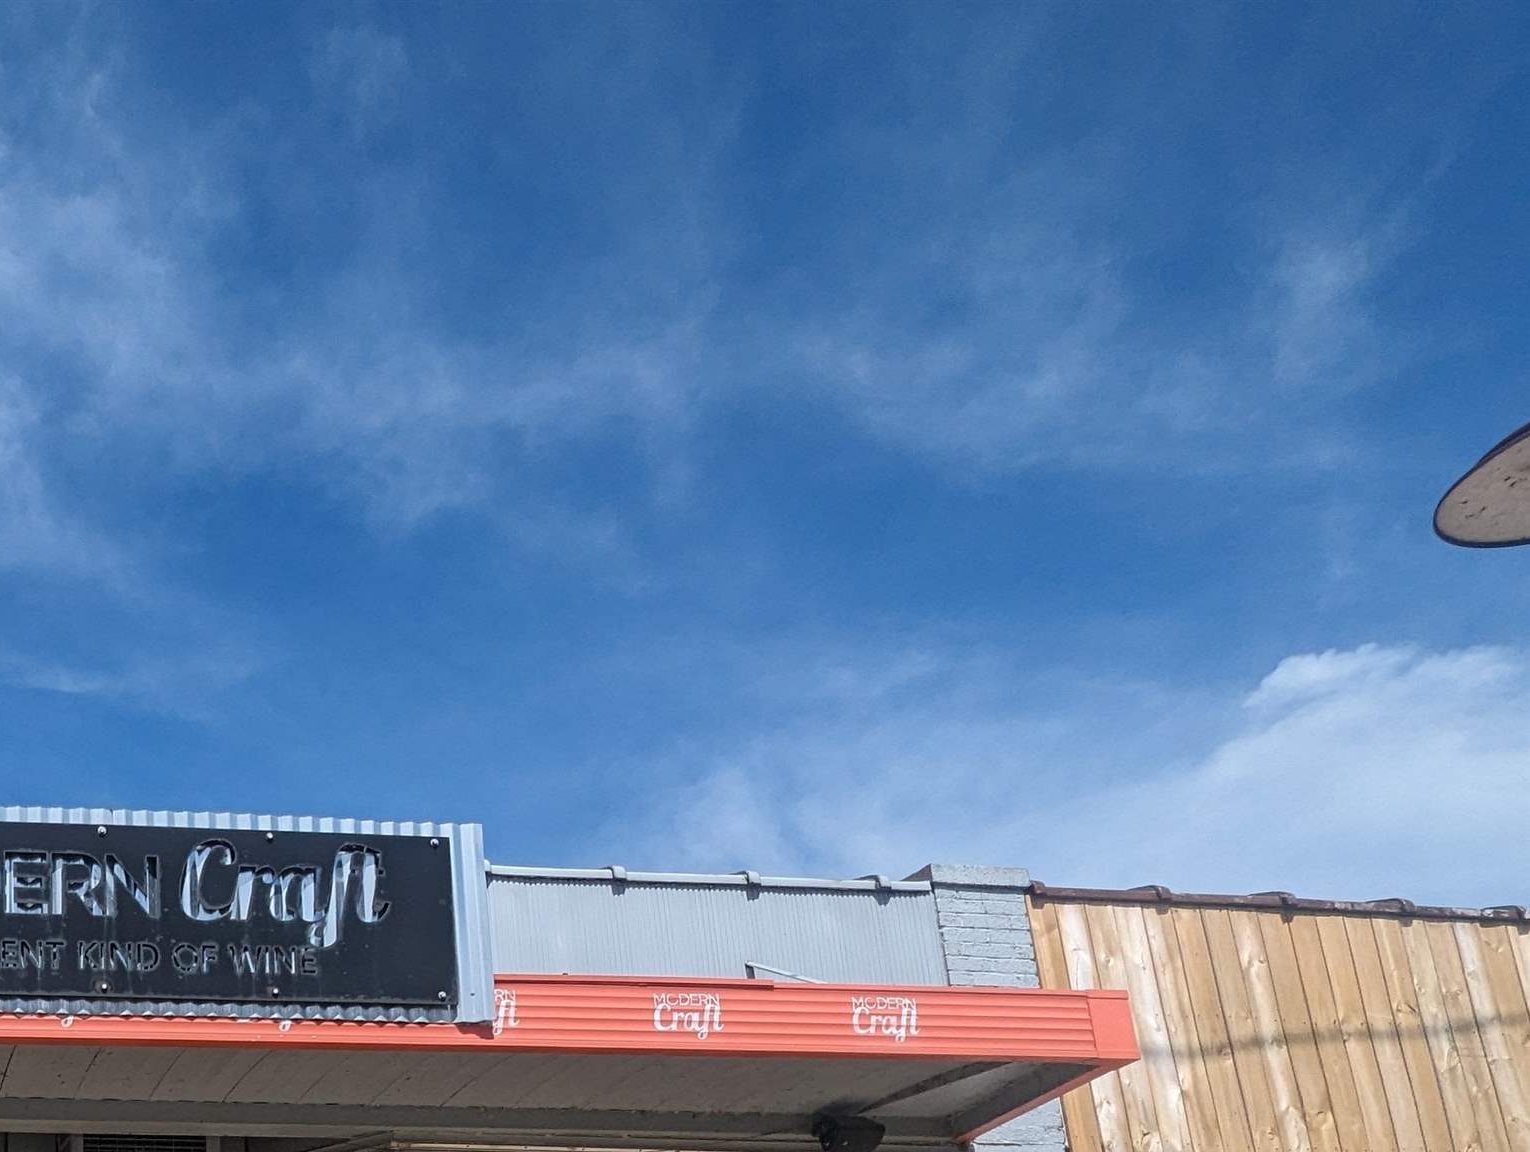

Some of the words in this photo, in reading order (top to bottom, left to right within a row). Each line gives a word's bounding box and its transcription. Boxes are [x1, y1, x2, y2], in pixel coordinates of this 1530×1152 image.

[180, 838, 390, 948] Craft
[78, 940, 160, 971] KIND
[172, 943, 218, 973] OF
[230, 943, 319, 975] WINE
[653, 993, 720, 1007] MODERN
[852, 996, 916, 1011] MODERN
[654, 1004, 724, 1040] Craft
[852, 1006, 919, 1043] Craft
